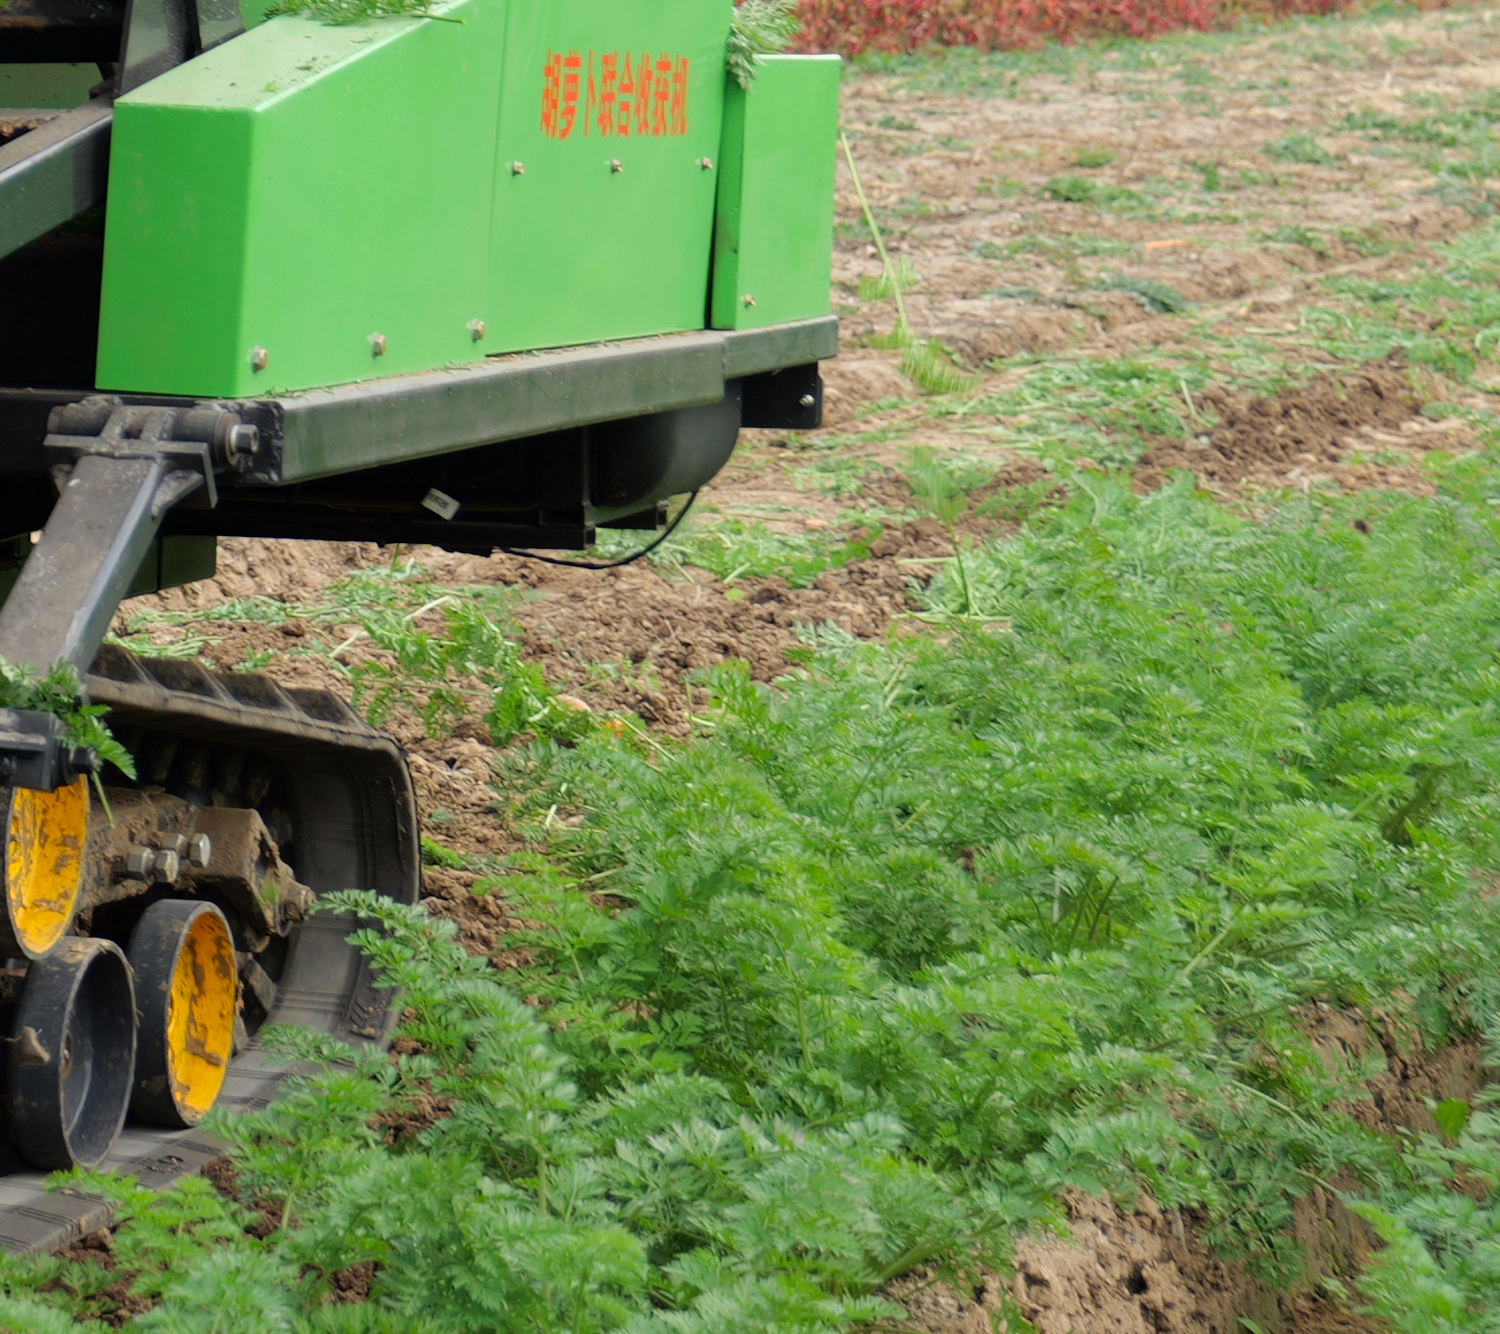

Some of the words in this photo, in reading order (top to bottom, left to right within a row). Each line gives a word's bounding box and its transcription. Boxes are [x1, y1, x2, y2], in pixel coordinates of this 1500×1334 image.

[539, 48, 690, 140] 胡萝卜联合收获机
